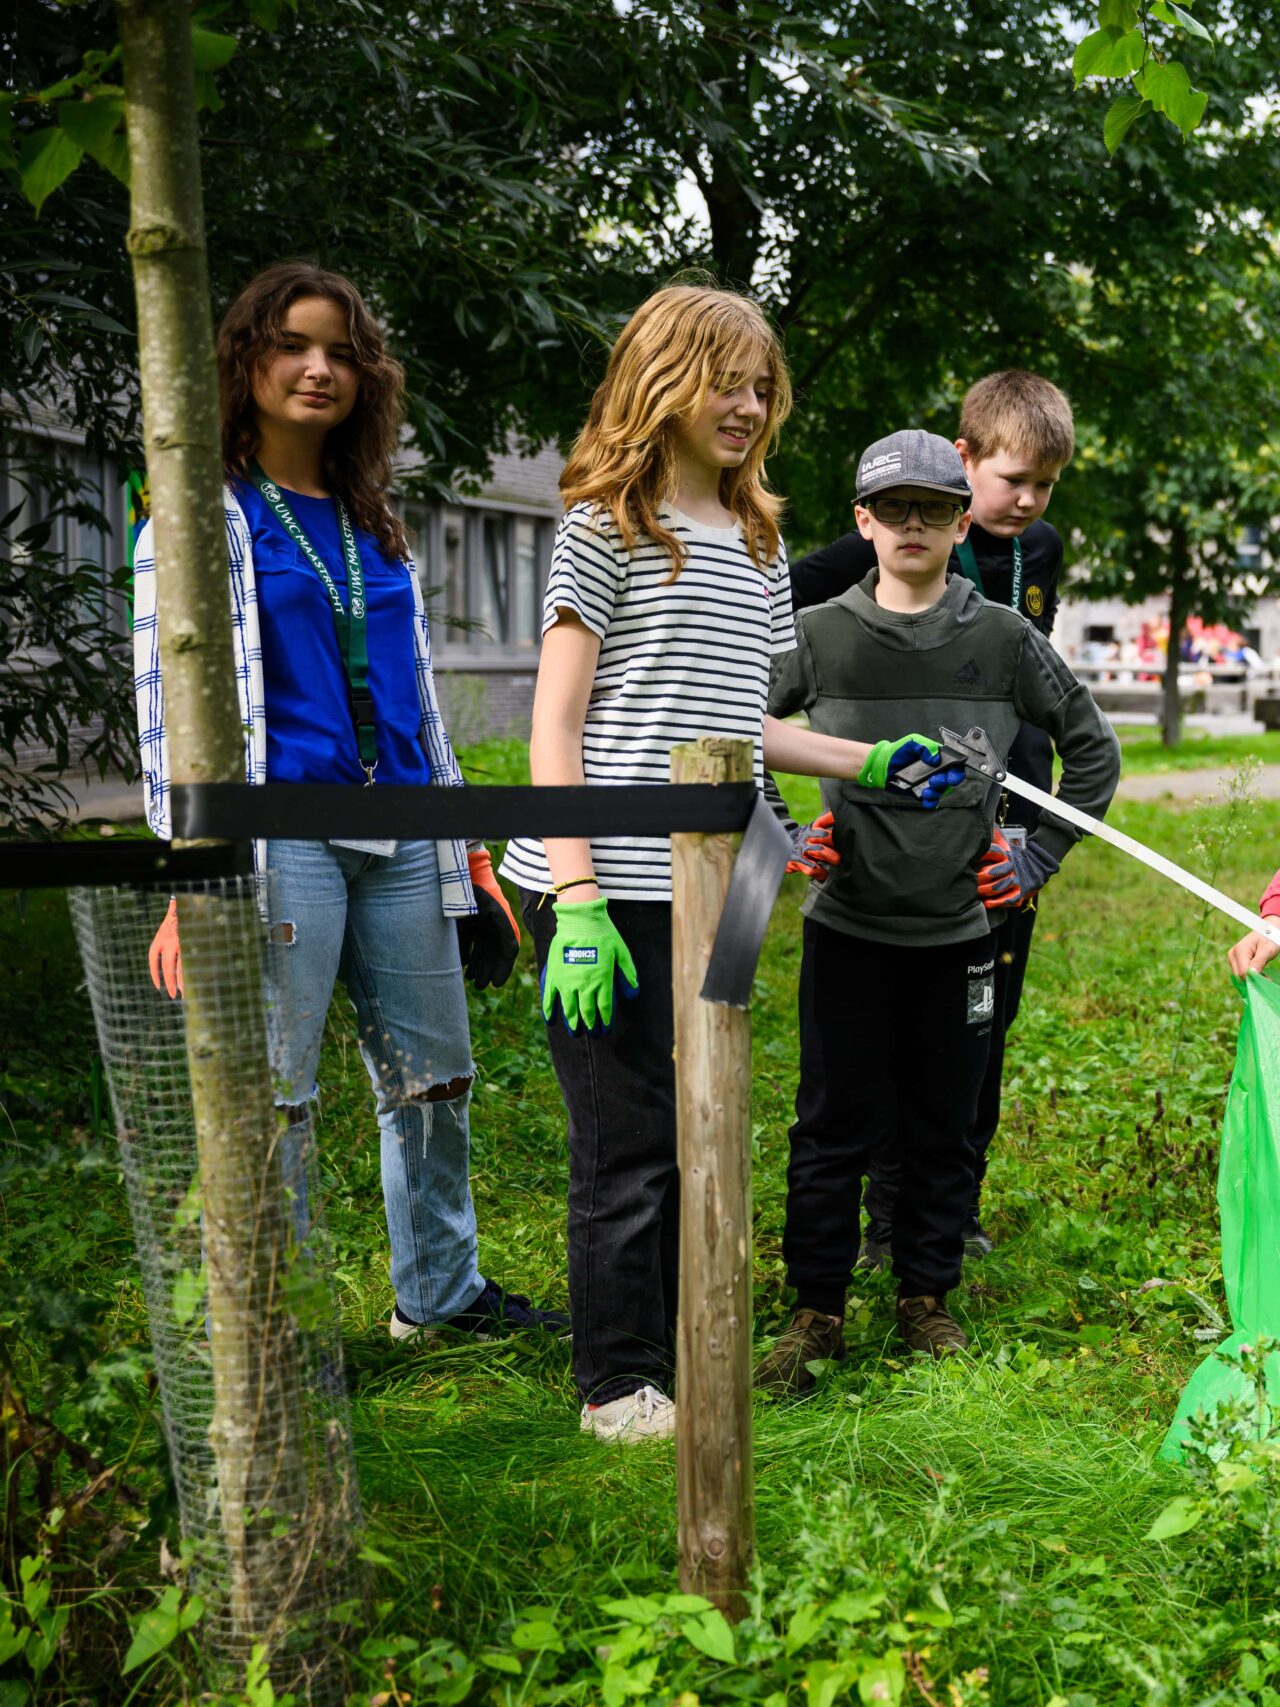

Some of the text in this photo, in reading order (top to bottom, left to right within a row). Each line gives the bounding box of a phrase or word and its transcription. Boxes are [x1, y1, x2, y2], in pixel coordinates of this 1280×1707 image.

[862, 451, 902, 473] WRC
[275, 503, 345, 616] UWC MAASTRICHT
[350, 565, 363, 596] UWC
